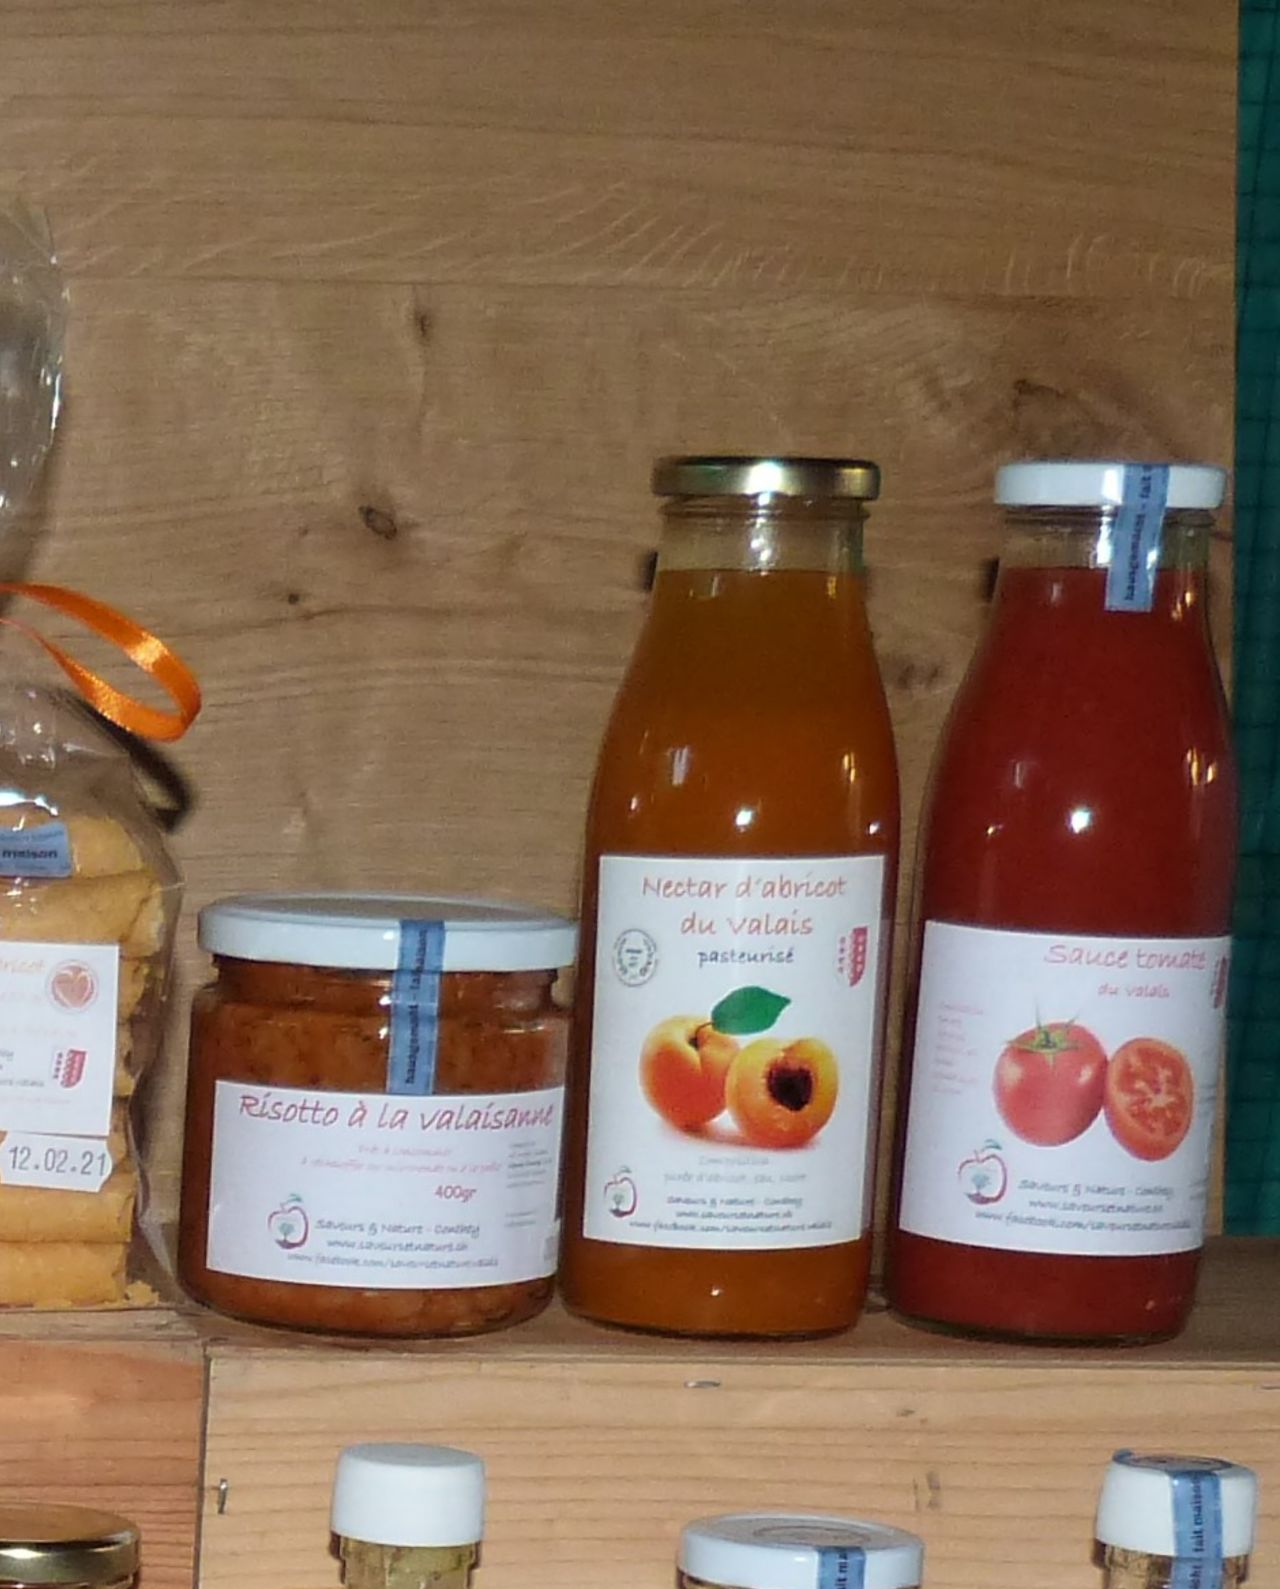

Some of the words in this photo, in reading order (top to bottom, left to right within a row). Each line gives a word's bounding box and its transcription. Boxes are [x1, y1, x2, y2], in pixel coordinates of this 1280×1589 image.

[2, 847, 58, 859] maison
[642, 875, 727, 898] Nectar
[735, 872, 847, 898] d'abricot
[681, 911, 715, 935] du
[726, 910, 813, 936] valais
[698, 947, 794, 967] pasteurisé
[1044, 944, 1129, 968] Sauce
[1136, 949, 1206, 971] tomate
[1098, 983, 1118, 997] du
[1126, 984, 1170, 998] valais
[240, 1092, 338, 1126] Risotto
[348, 1101, 368, 1129] à
[377, 1104, 408, 1129] la
[420, 1103, 554, 1132] valaisanne
[9, 1145, 107, 1176] 12.02.21
[435, 1184, 477, 1203] 400gr
